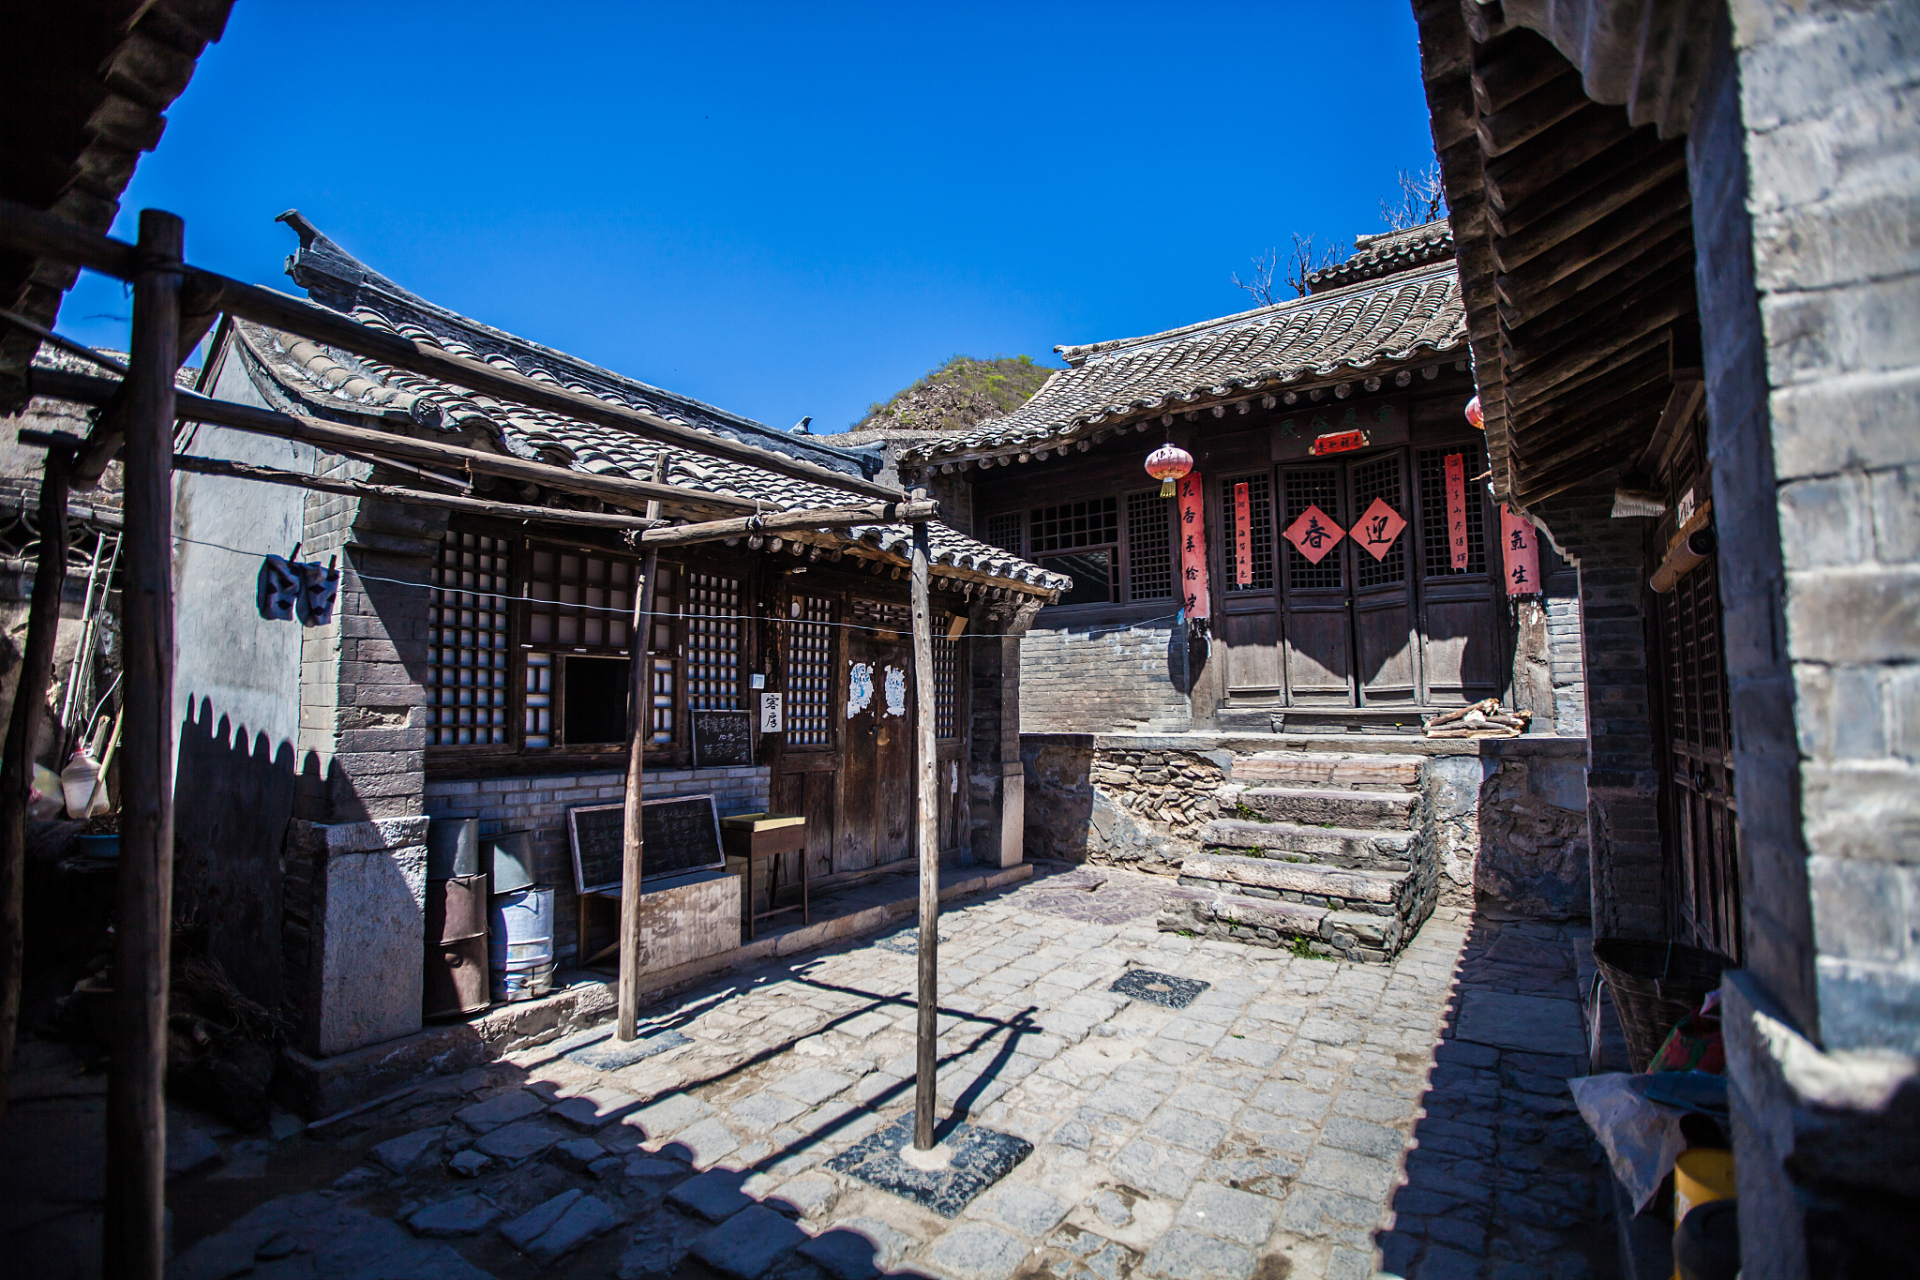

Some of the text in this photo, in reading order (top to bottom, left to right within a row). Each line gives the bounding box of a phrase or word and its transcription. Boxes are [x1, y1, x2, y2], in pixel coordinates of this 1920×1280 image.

[1300, 515, 1331, 550] 春
[1365, 514, 1393, 546] 迎
[764, 694, 780, 729] 客房
